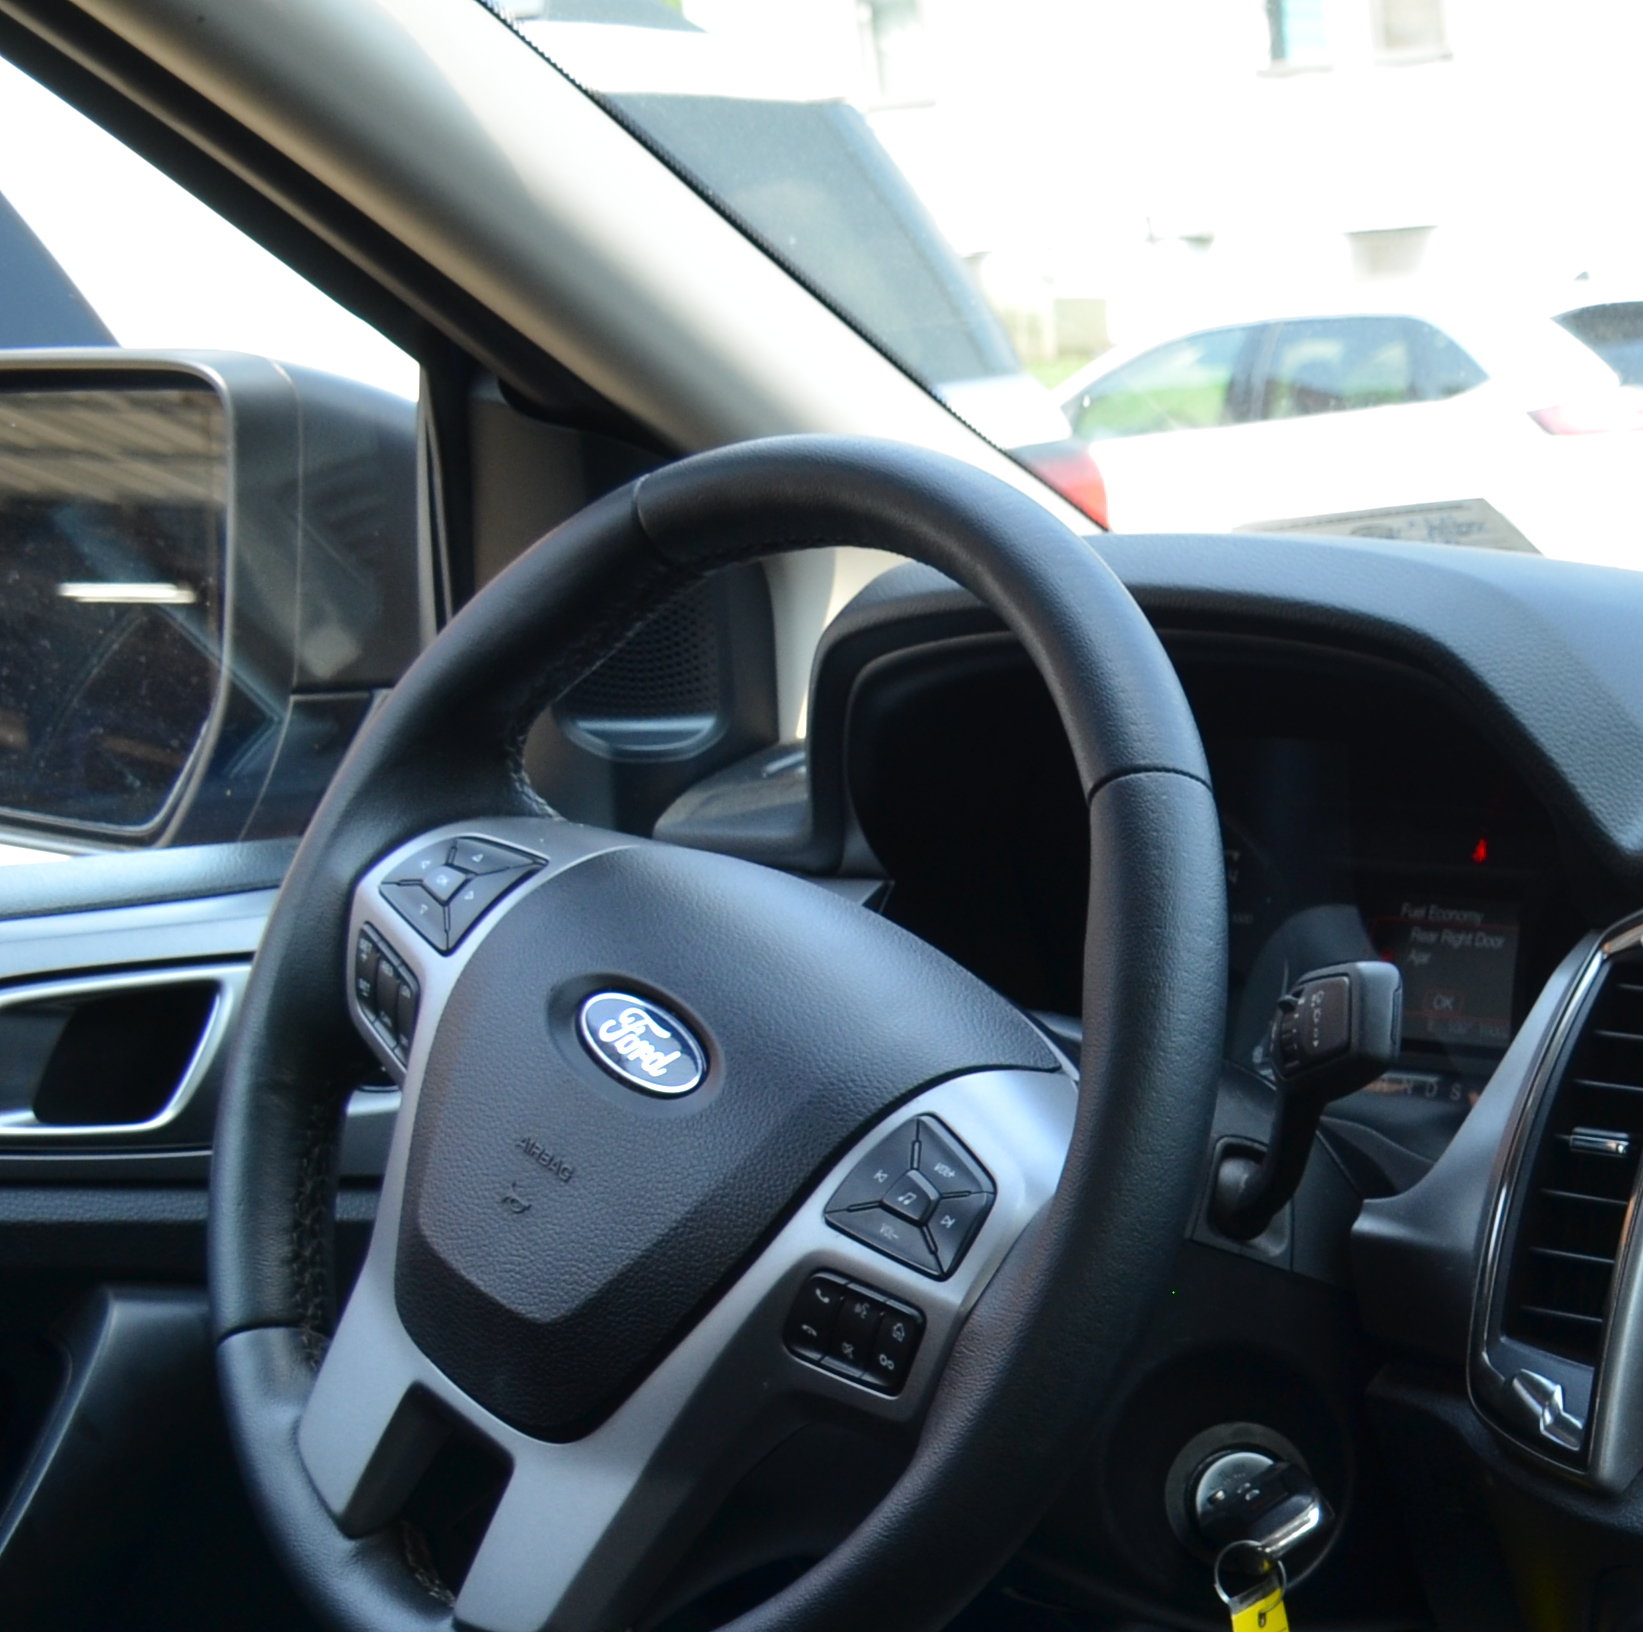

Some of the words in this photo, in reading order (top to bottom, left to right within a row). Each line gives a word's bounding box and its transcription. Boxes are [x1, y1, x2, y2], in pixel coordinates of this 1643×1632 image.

[1402, 902, 1427, 918] Fuel
[1428, 905, 1484, 925] Economy
[1411, 926, 1438, 942] Rear
[1441, 929, 1472, 948] Right
[1474, 931, 1505, 949] Door
[1433, 994, 1455, 1010] OK
[598, 1007, 681, 1077] Ford
[515, 1137, 576, 1184] AIRBAG
